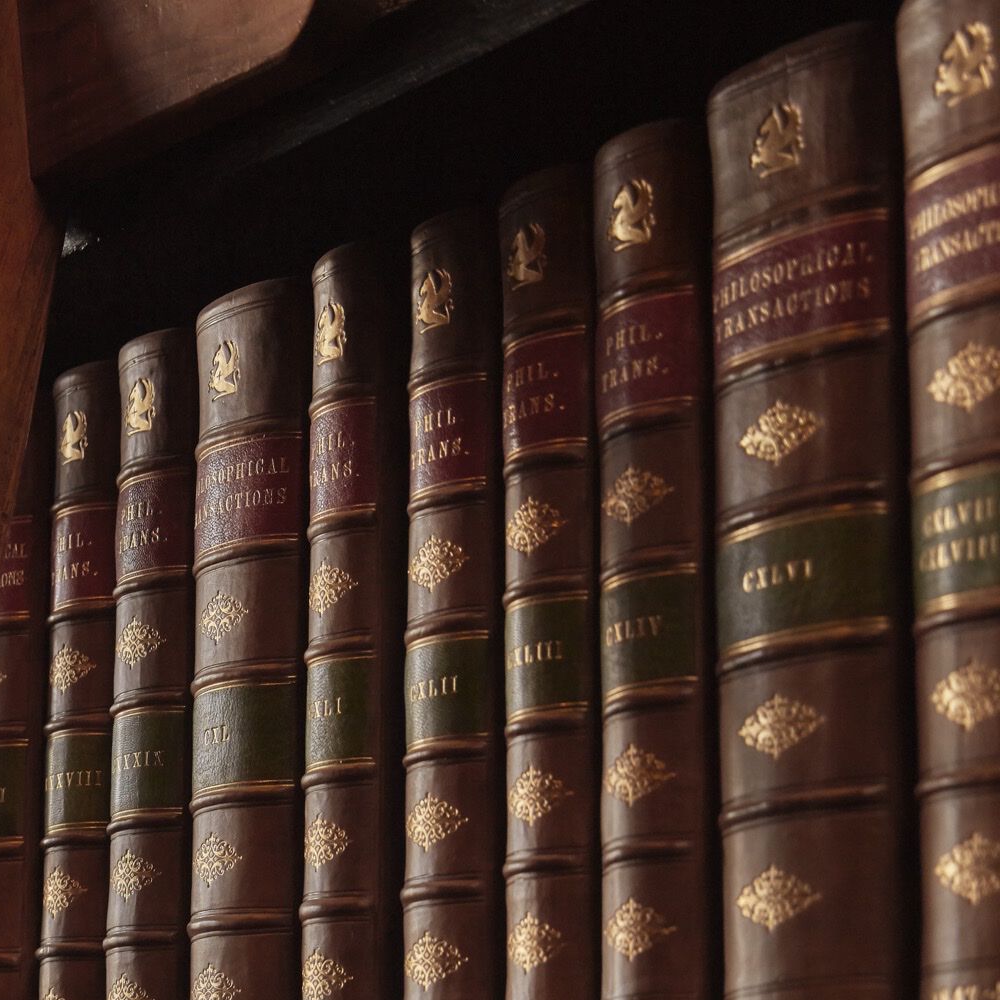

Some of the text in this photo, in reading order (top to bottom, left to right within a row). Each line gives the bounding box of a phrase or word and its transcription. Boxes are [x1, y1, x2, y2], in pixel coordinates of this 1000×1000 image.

[713, 241, 875, 314] PHILOSOPHICAL
[715, 277, 871, 344] TRANSACTIONS
[605, 324, 664, 357] PHIL.
[602, 354, 670, 393] TRANS.
[410, 437, 471, 473] TRANS.
[741, 557, 815, 594] CXLVI
[409, 673, 459, 703] CXLII
[203, 724, 230, 745] CXL
[111, 749, 165, 774] XXXIX
